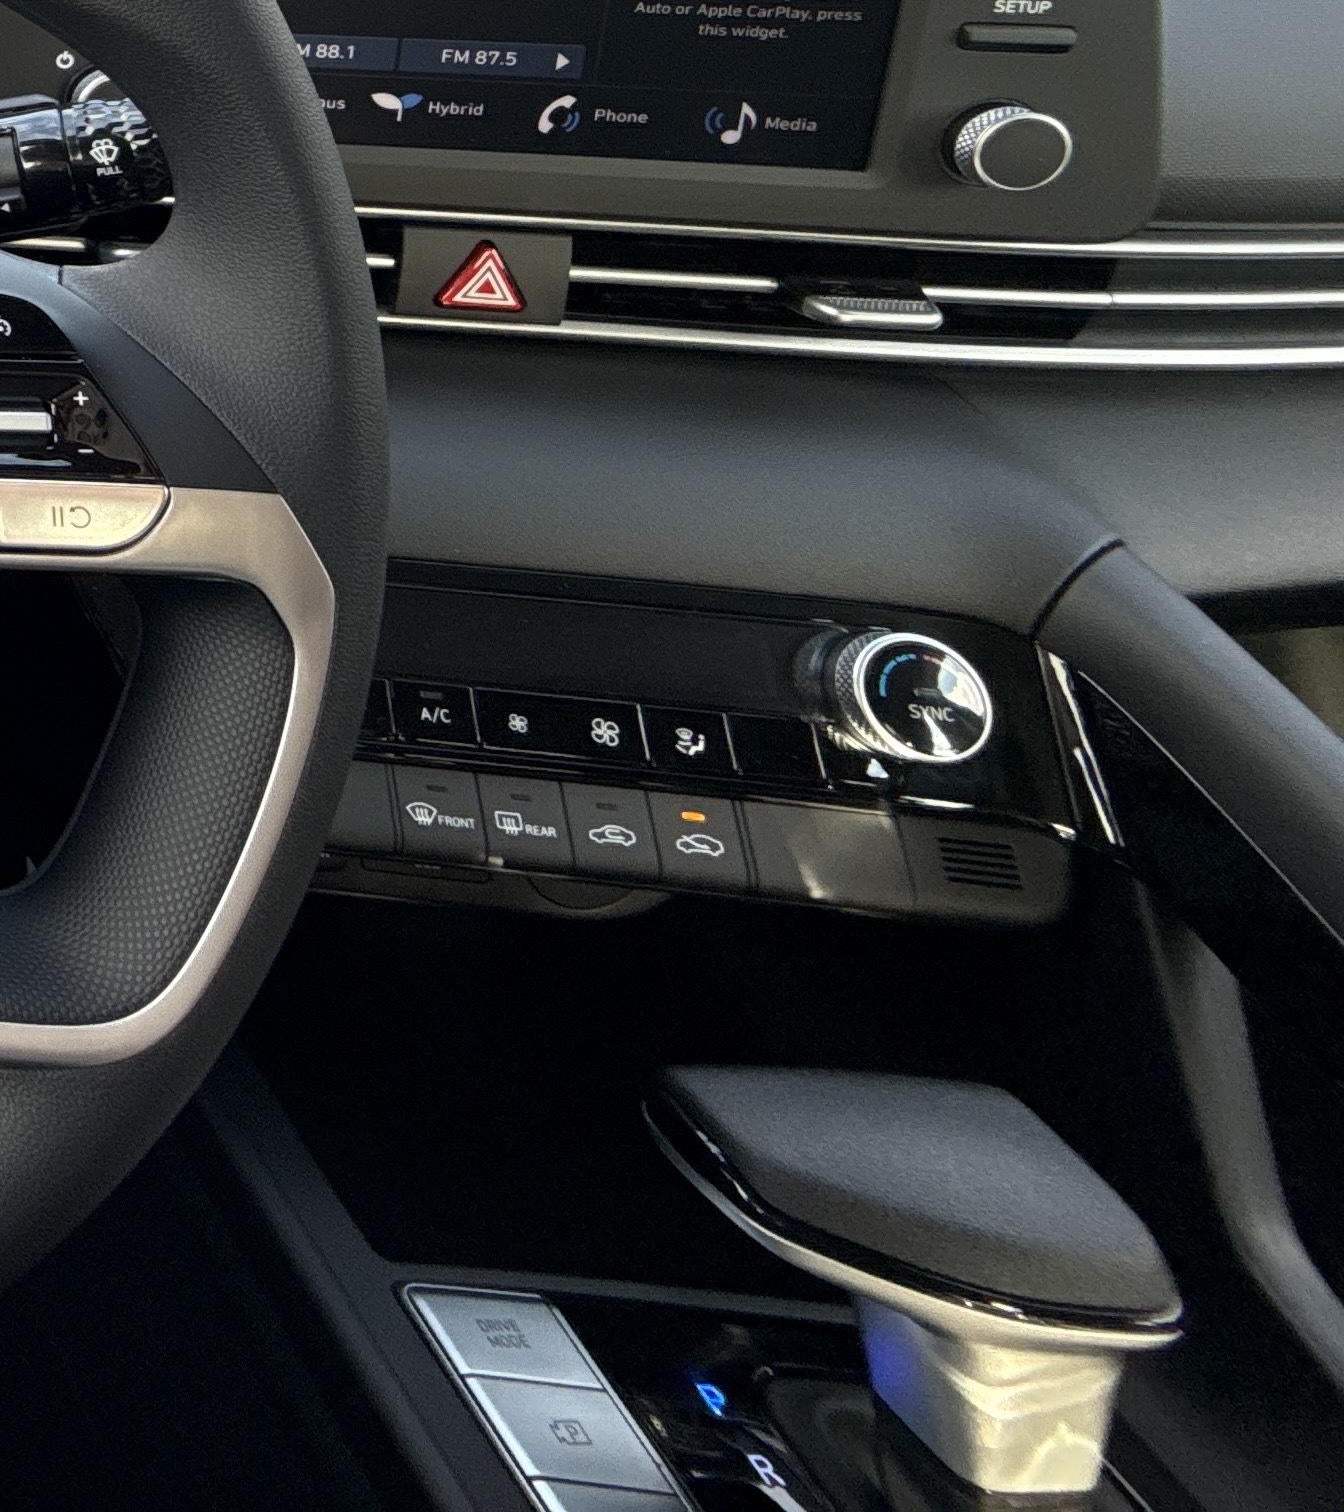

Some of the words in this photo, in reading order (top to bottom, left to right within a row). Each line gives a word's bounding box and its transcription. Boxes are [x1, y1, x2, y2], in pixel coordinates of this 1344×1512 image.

[634, 1, 671, 15] Auto
[675, 5, 691, 15] or
[696, 3, 742, 19] Apple
[816, 9, 862, 22] press
[993, 0, 1052, 14] SETUP
[698, 23, 727, 37] this
[731, 25, 789, 40] widget.
[315, 43, 355, 60] 88.1
[440, 48, 469, 65] FM
[474, 50, 517, 66] 87.5
[427, 100, 484, 117] Hybrid
[594, 108, 649, 124] Phone
[764, 117, 818, 132] Media
[420, 706, 452, 724] A/C
[908, 703, 956, 722] SYNC
[437, 814, 476, 830] FRONT
[525, 824, 558, 838] REAR
[486, 1334, 532, 1349] MODE
[746, 1453, 787, 1487] R
